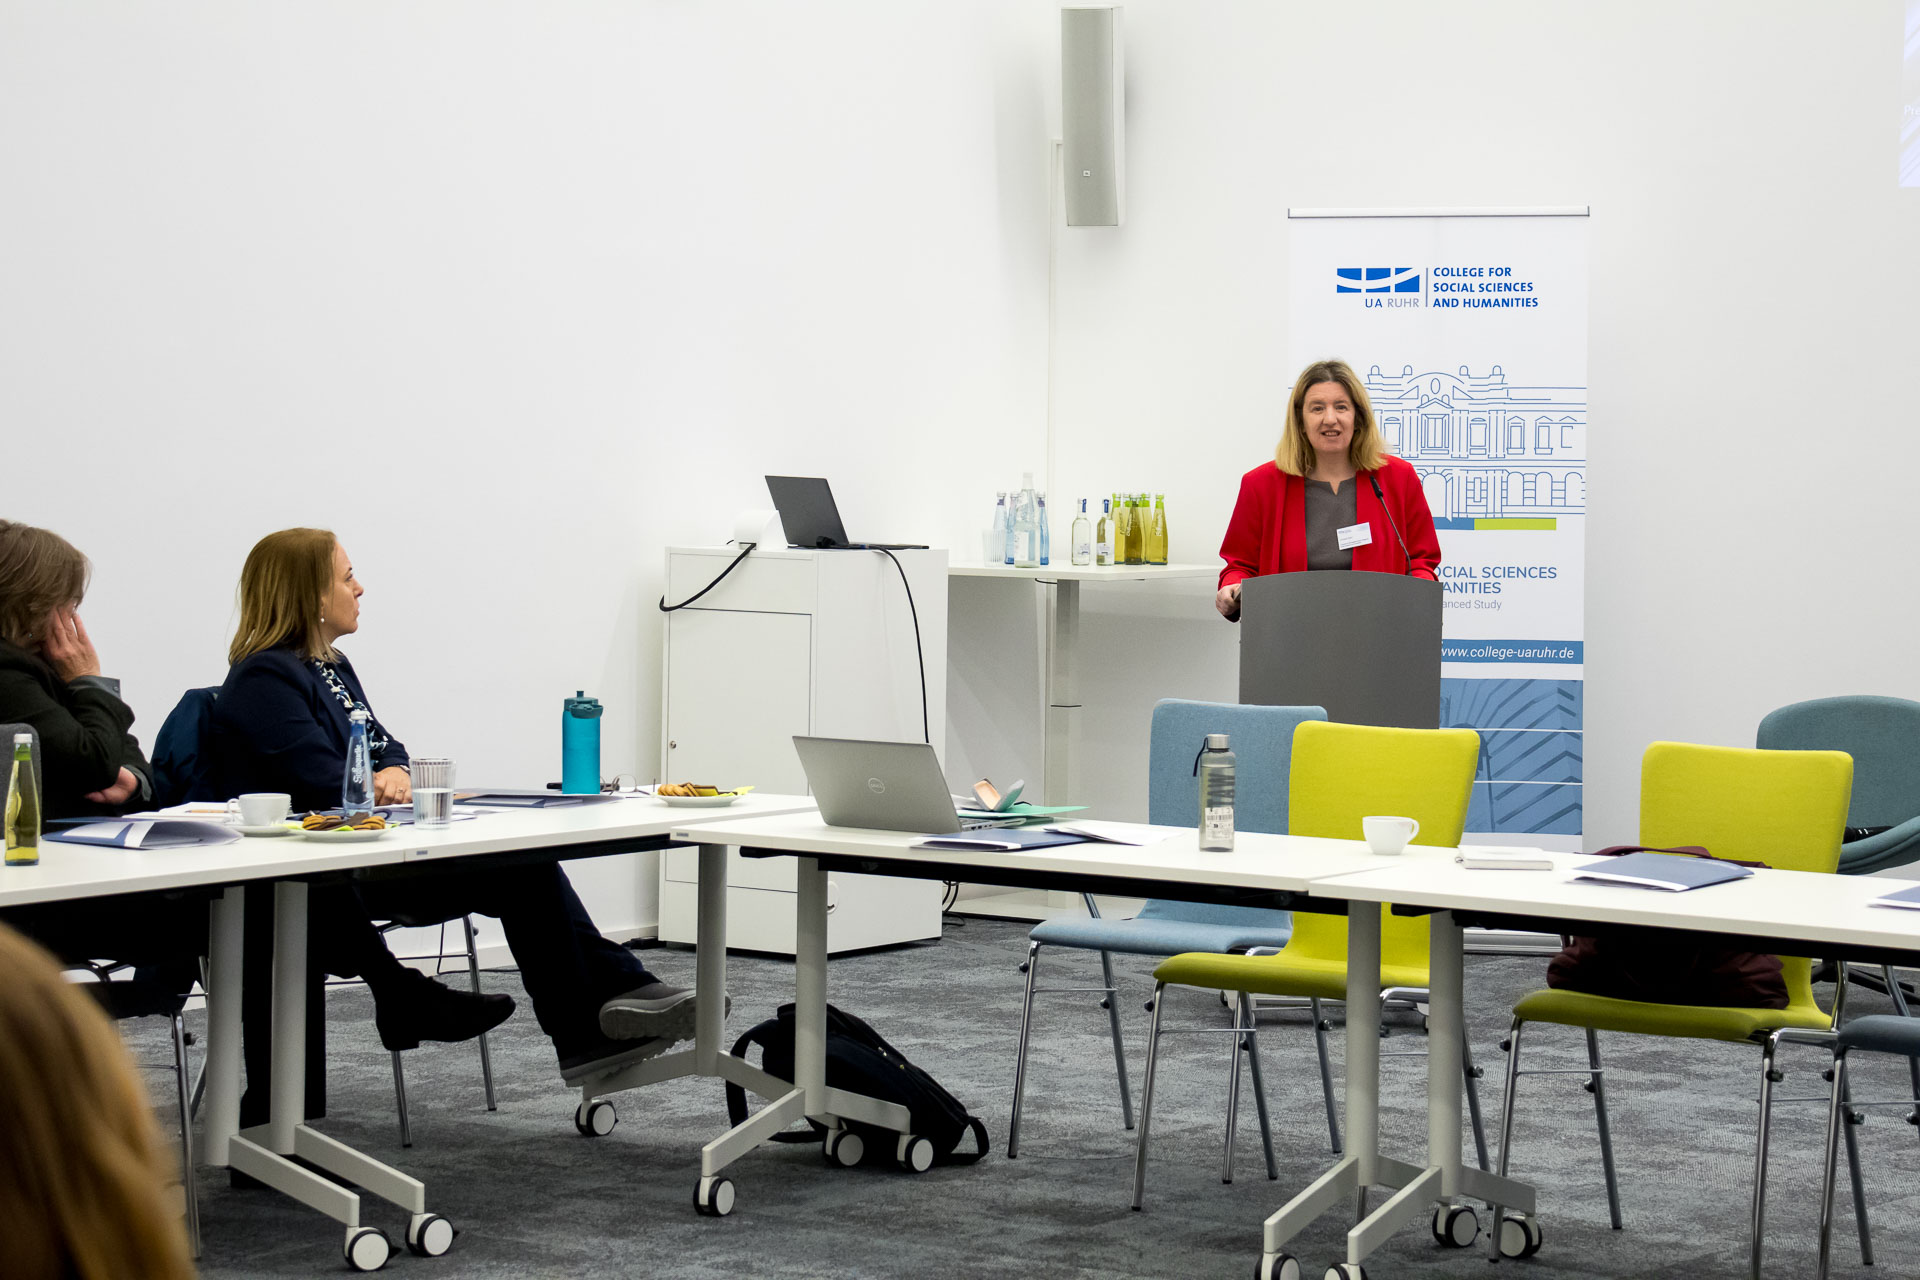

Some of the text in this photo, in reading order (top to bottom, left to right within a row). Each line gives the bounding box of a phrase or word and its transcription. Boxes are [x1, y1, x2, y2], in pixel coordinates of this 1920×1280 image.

[1433, 266, 1512, 278] COLLEGE FOR
[1433, 282, 1534, 293] SOCIAL SCIENCES
[1365, 298, 1420, 308] UA RUHR
[1432, 297, 1539, 308] AND HUMANITIES
[1436, 566, 1557, 579] CIAL SCIENCES
[1443, 581, 1502, 594] ANITIES
[1442, 600, 1502, 611] anced Study
